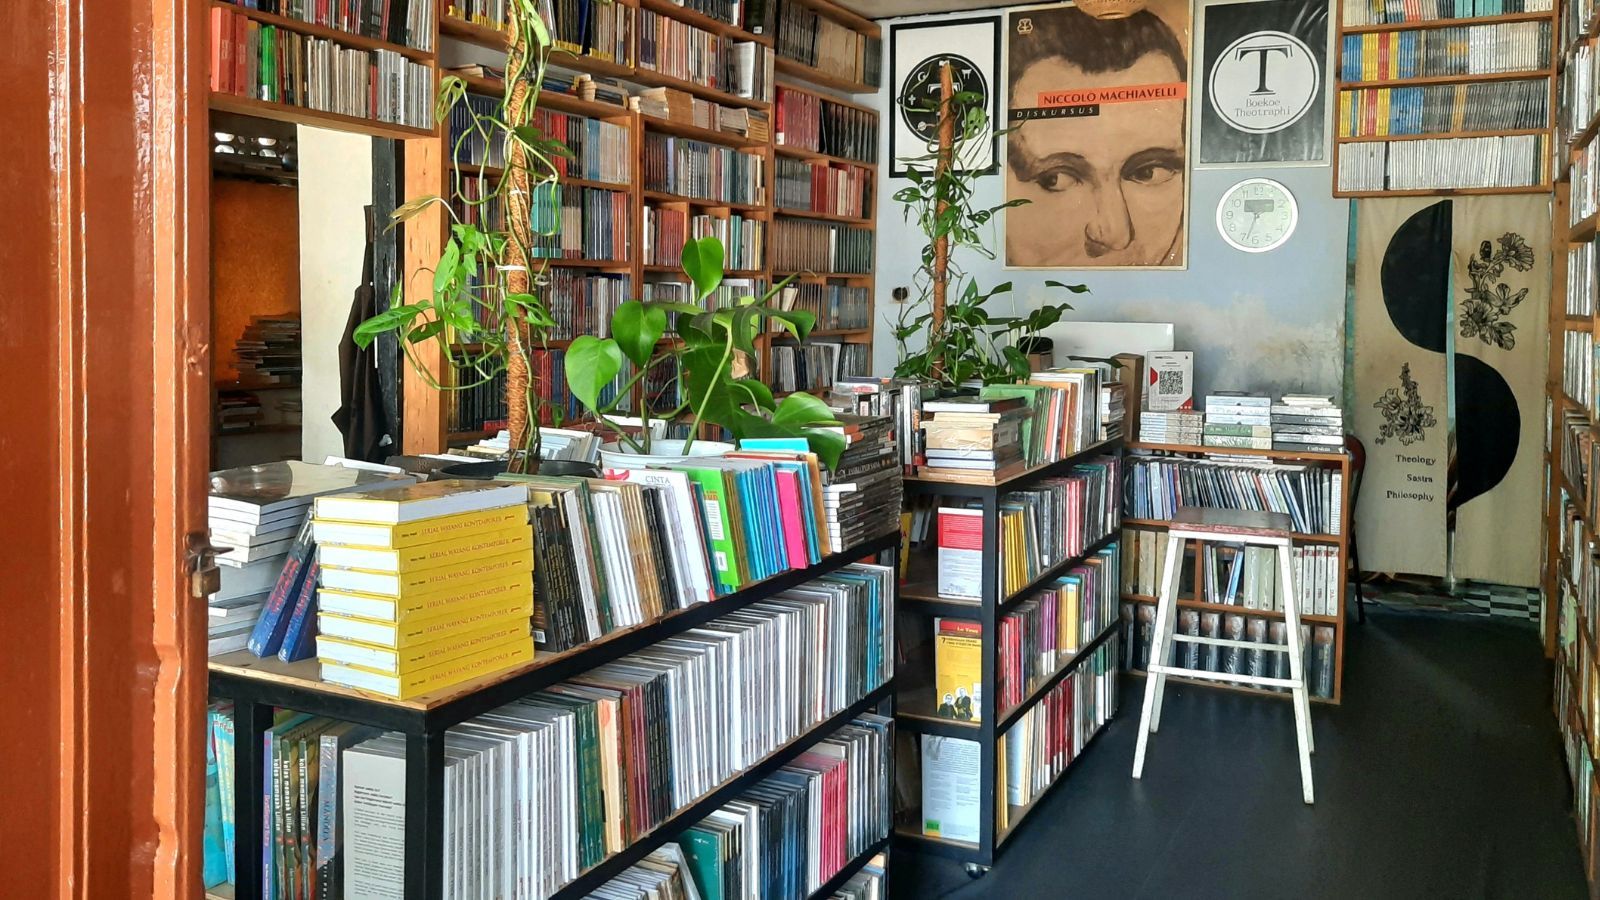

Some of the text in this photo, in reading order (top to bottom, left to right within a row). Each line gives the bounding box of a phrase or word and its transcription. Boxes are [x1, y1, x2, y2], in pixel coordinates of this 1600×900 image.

[1043, 87, 1177, 104] NICCOLO MACHIAVELLI
[1245, 98, 1280, 107] Boekoe
[1016, 106, 1094, 118] DISKURSUS
[1234, 106, 1290, 117] Theotraphi
[1395, 454, 1436, 465] Theology
[1406, 474, 1433, 483] Sastra
[1386, 490, 1435, 502] Philosophy
